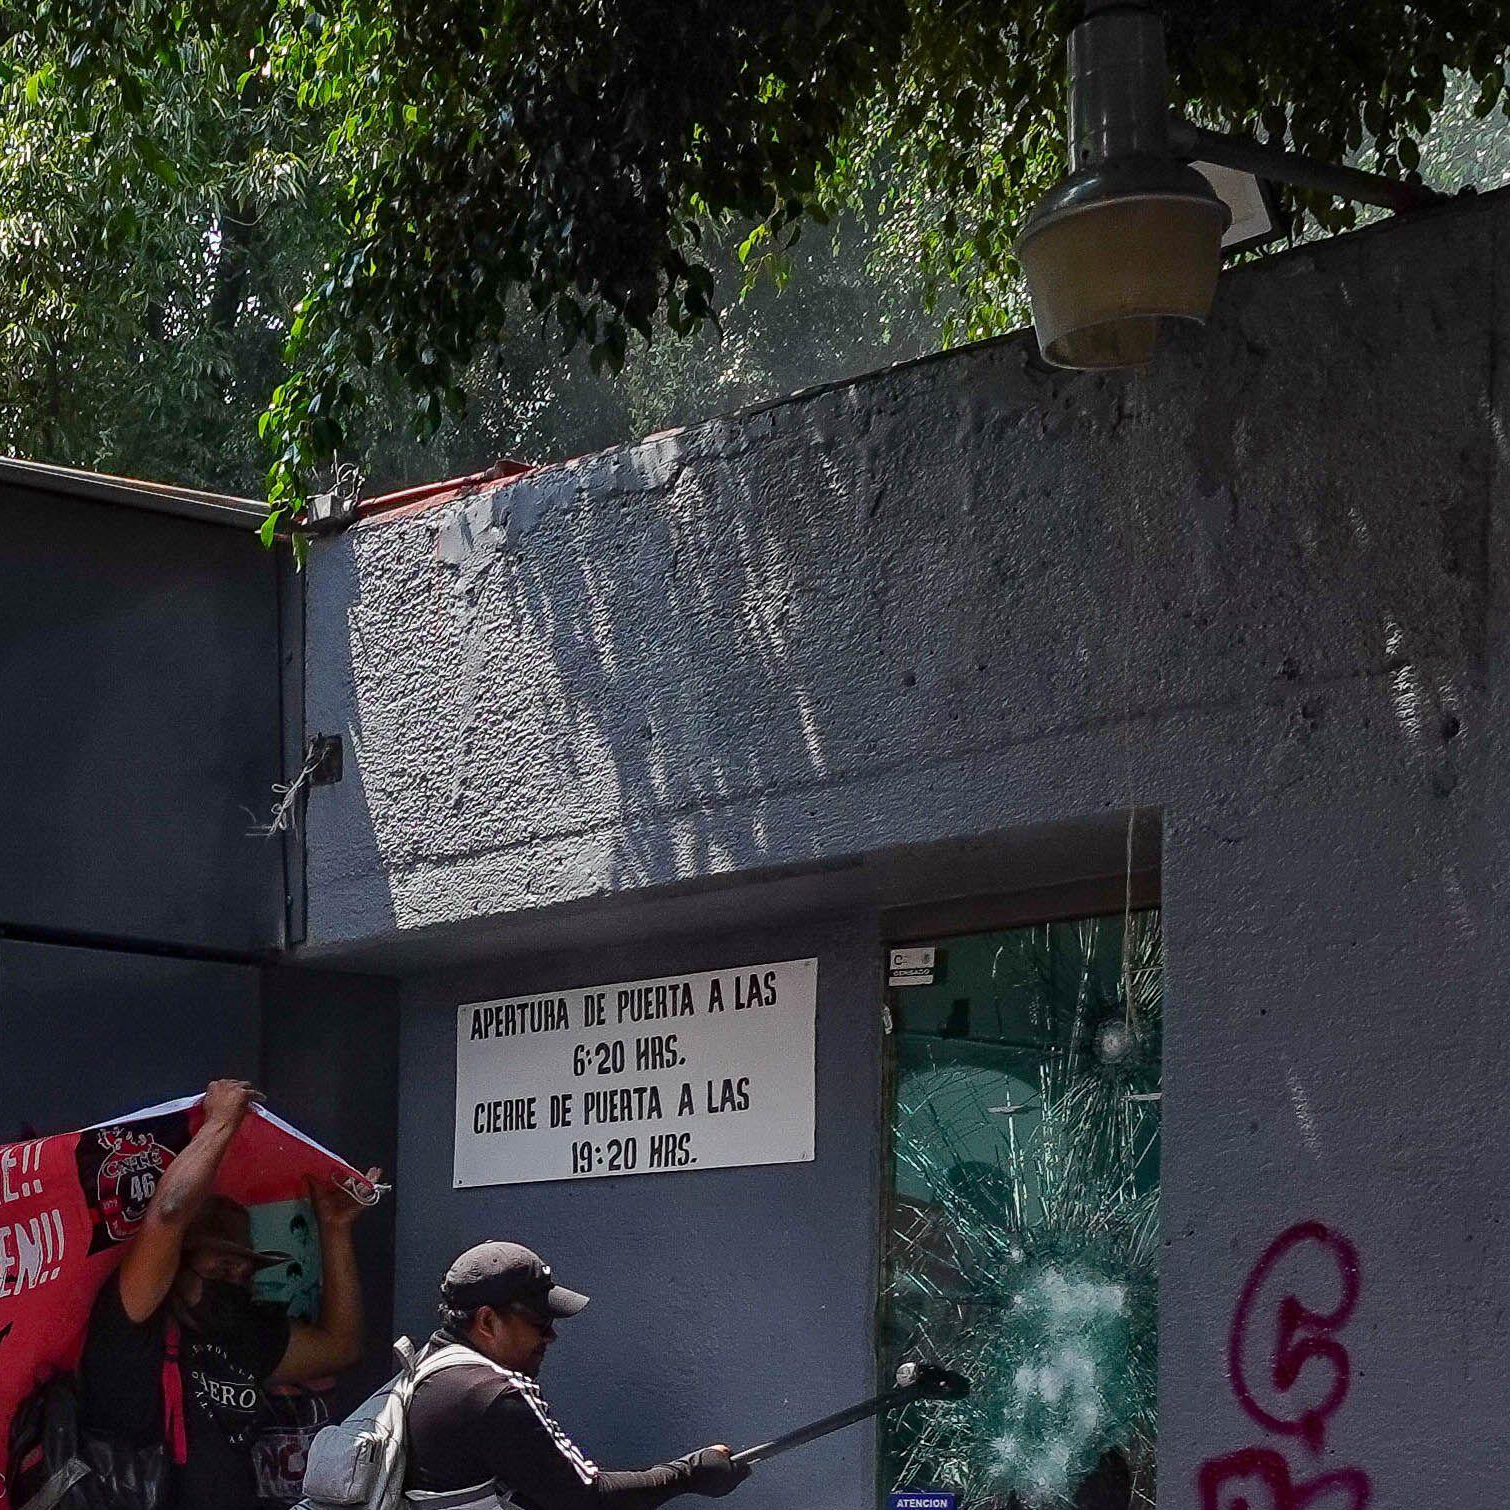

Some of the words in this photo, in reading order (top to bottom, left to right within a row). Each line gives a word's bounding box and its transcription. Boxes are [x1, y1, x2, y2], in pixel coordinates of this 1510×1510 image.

[470, 997, 570, 1041] APERTURA
[583, 993, 606, 1028] DE
[617, 982, 694, 1025] PUERTA
[708, 973, 725, 1013] A
[734, 970, 778, 1011] LAS
[573, 1039, 625, 1077] 6:20
[635, 1033, 687, 1072] HRS.
[473, 1096, 538, 1135] CIERRE
[549, 1093, 572, 1129] DE
[583, 1085, 663, 1126] PUERTA
[677, 1082, 695, 1117] A
[706, 1076, 751, 1115] LAS
[571, 1140, 637, 1174] 19:20
[649, 1132, 698, 1169] HRS.
[130, 1172, 156, 1203] 46
[896, 1498, 948, 1508] ATENCION
